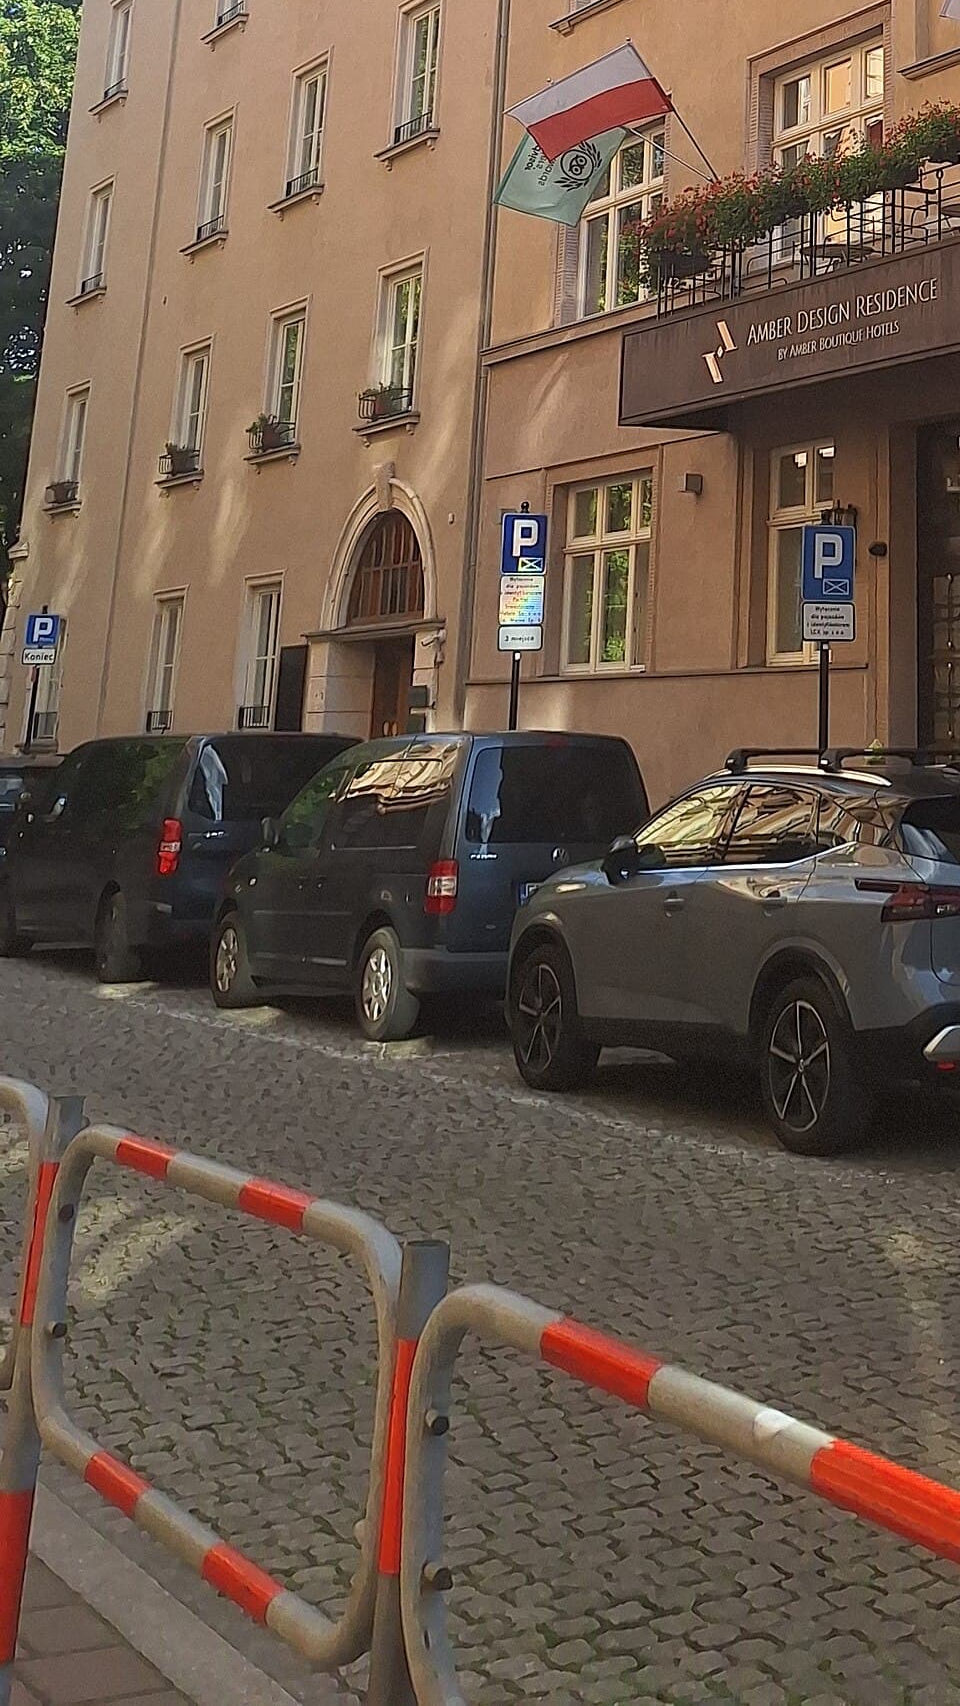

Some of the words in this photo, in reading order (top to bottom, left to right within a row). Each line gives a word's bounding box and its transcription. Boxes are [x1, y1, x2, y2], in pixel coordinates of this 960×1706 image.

[747, 316, 792, 345] AMBER
[797, 301, 850, 333] DESIGN
[856, 278, 938, 318] RESIDENCE
[778, 347, 788, 361] BY
[789, 341, 817, 358] AMBER
[820, 330, 863, 351] BOUTIQUE
[866, 320, 899, 340] HOTELS
[512, 519, 539, 557] P
[814, 533, 843, 579] P
[33, 617, 54, 643] P
[24, 652, 54, 661] Koniec
